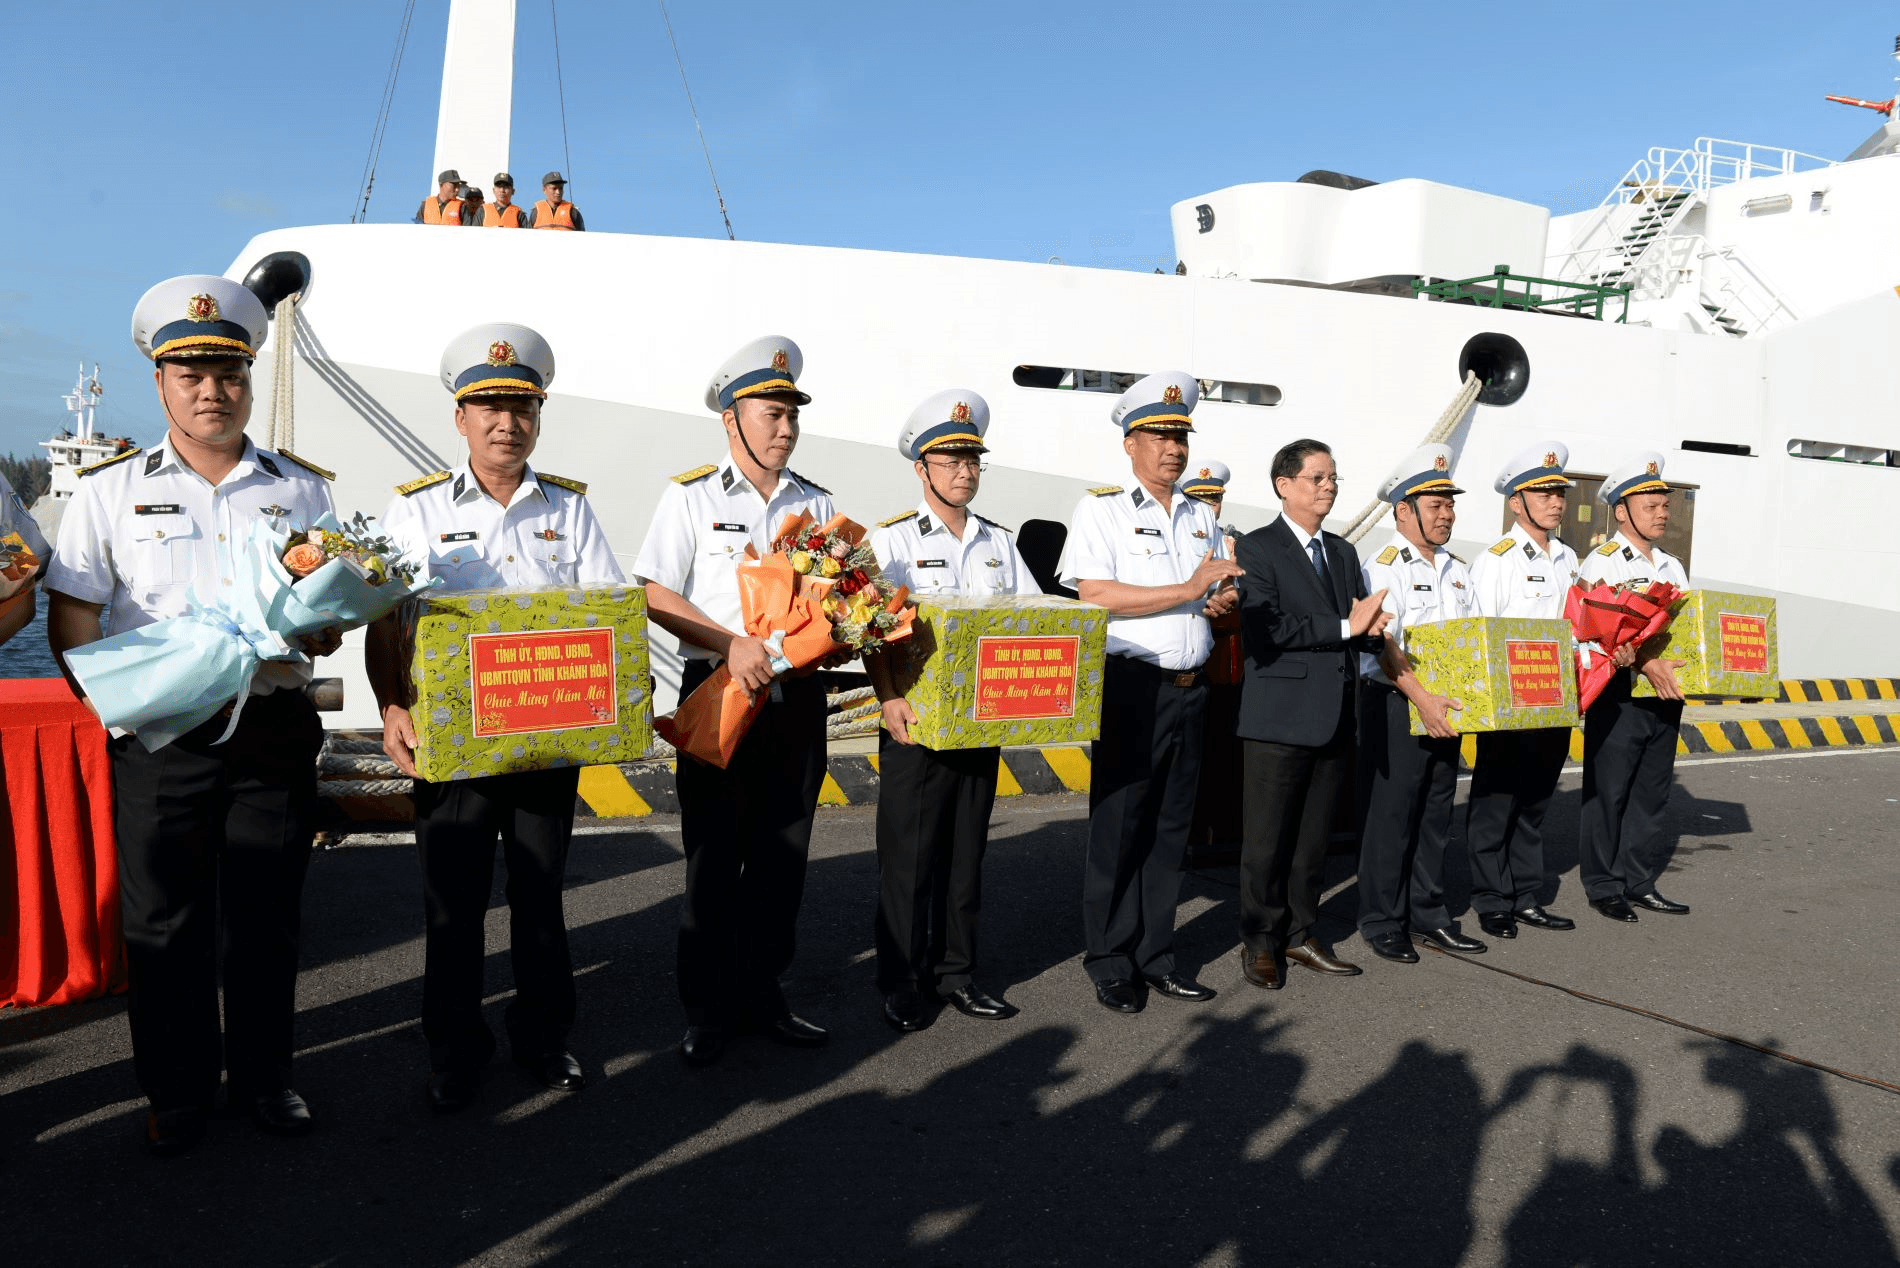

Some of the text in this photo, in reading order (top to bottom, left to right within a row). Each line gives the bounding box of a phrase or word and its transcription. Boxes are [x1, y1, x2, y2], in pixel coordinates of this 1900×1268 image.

[480, 660, 608, 686] UBMTTQVN TỈNH KHÁNH HÒA
[484, 685, 606, 709] Chúc Mừng Năm Mới
